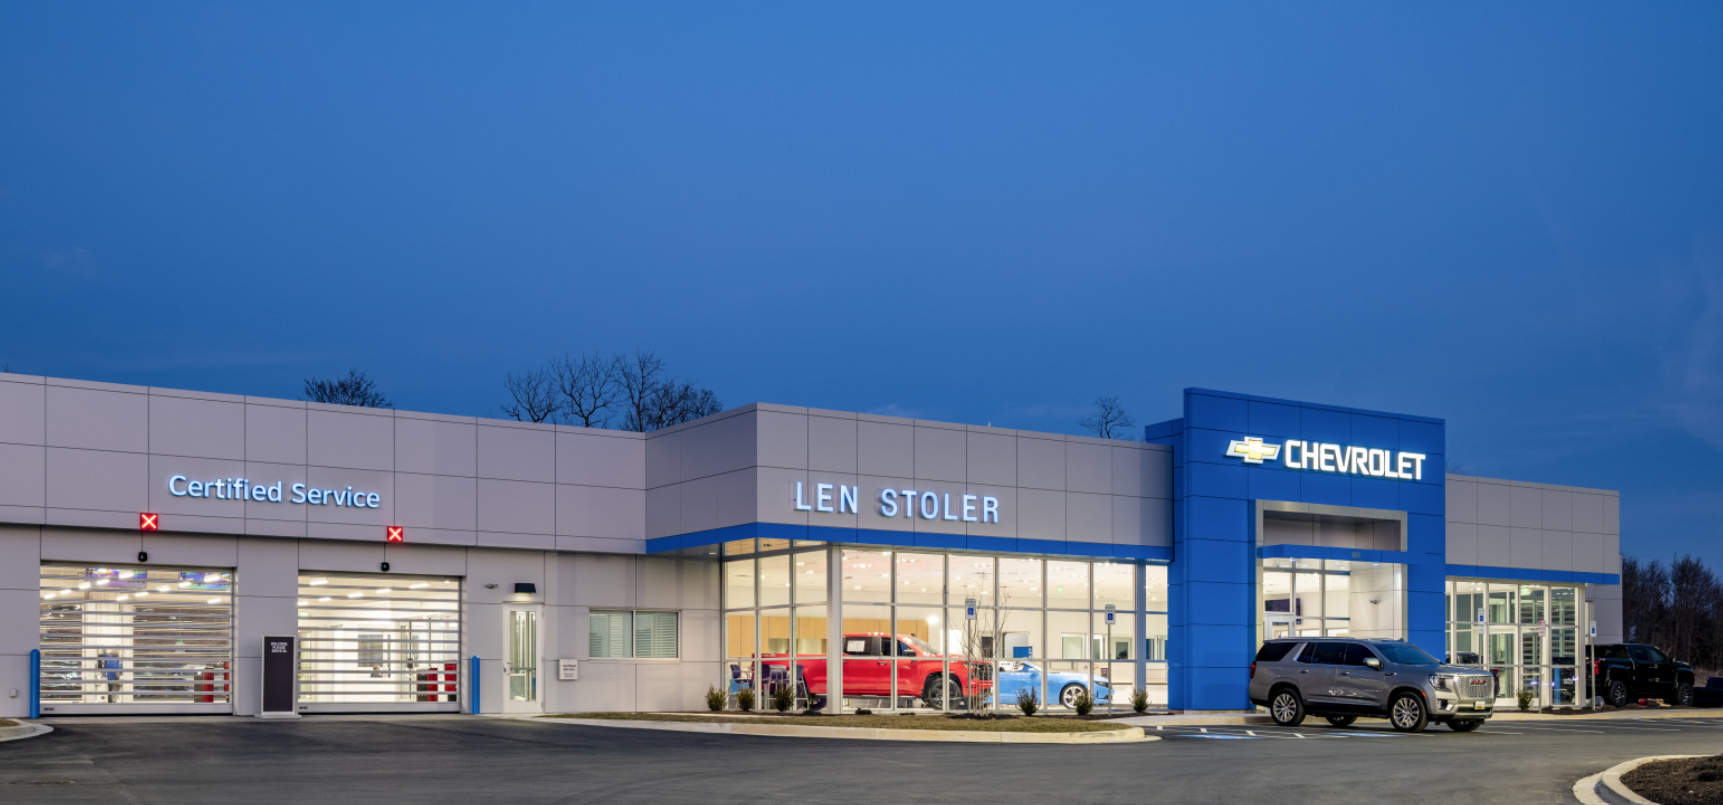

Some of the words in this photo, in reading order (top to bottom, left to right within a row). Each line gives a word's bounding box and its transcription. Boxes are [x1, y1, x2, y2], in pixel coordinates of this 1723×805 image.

[1285, 439, 1426, 480] CHEVROLET
[168, 474, 282, 503] Certified
[290, 482, 380, 508] Service
[795, 481, 859, 514] LEN
[880, 487, 999, 524] STOLER
